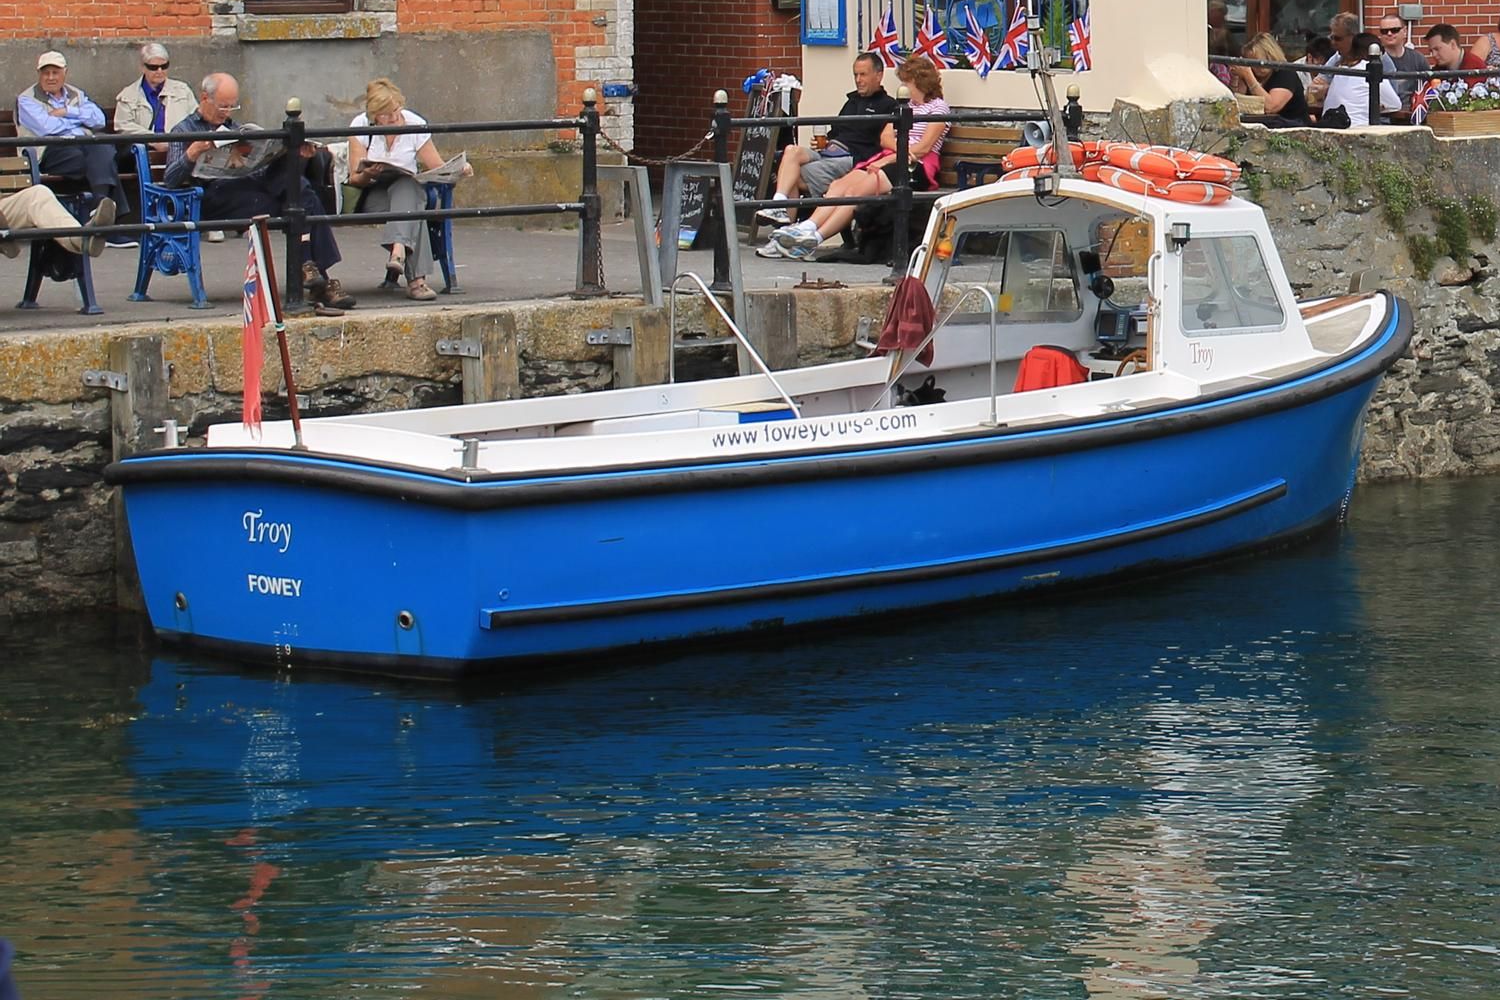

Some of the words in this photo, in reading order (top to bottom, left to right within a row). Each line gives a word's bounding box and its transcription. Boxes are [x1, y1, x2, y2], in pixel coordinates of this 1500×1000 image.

[1188, 341, 1214, 371] Troy
[242, 508, 292, 553] Troy
[248, 574, 302, 597] FOWEY
